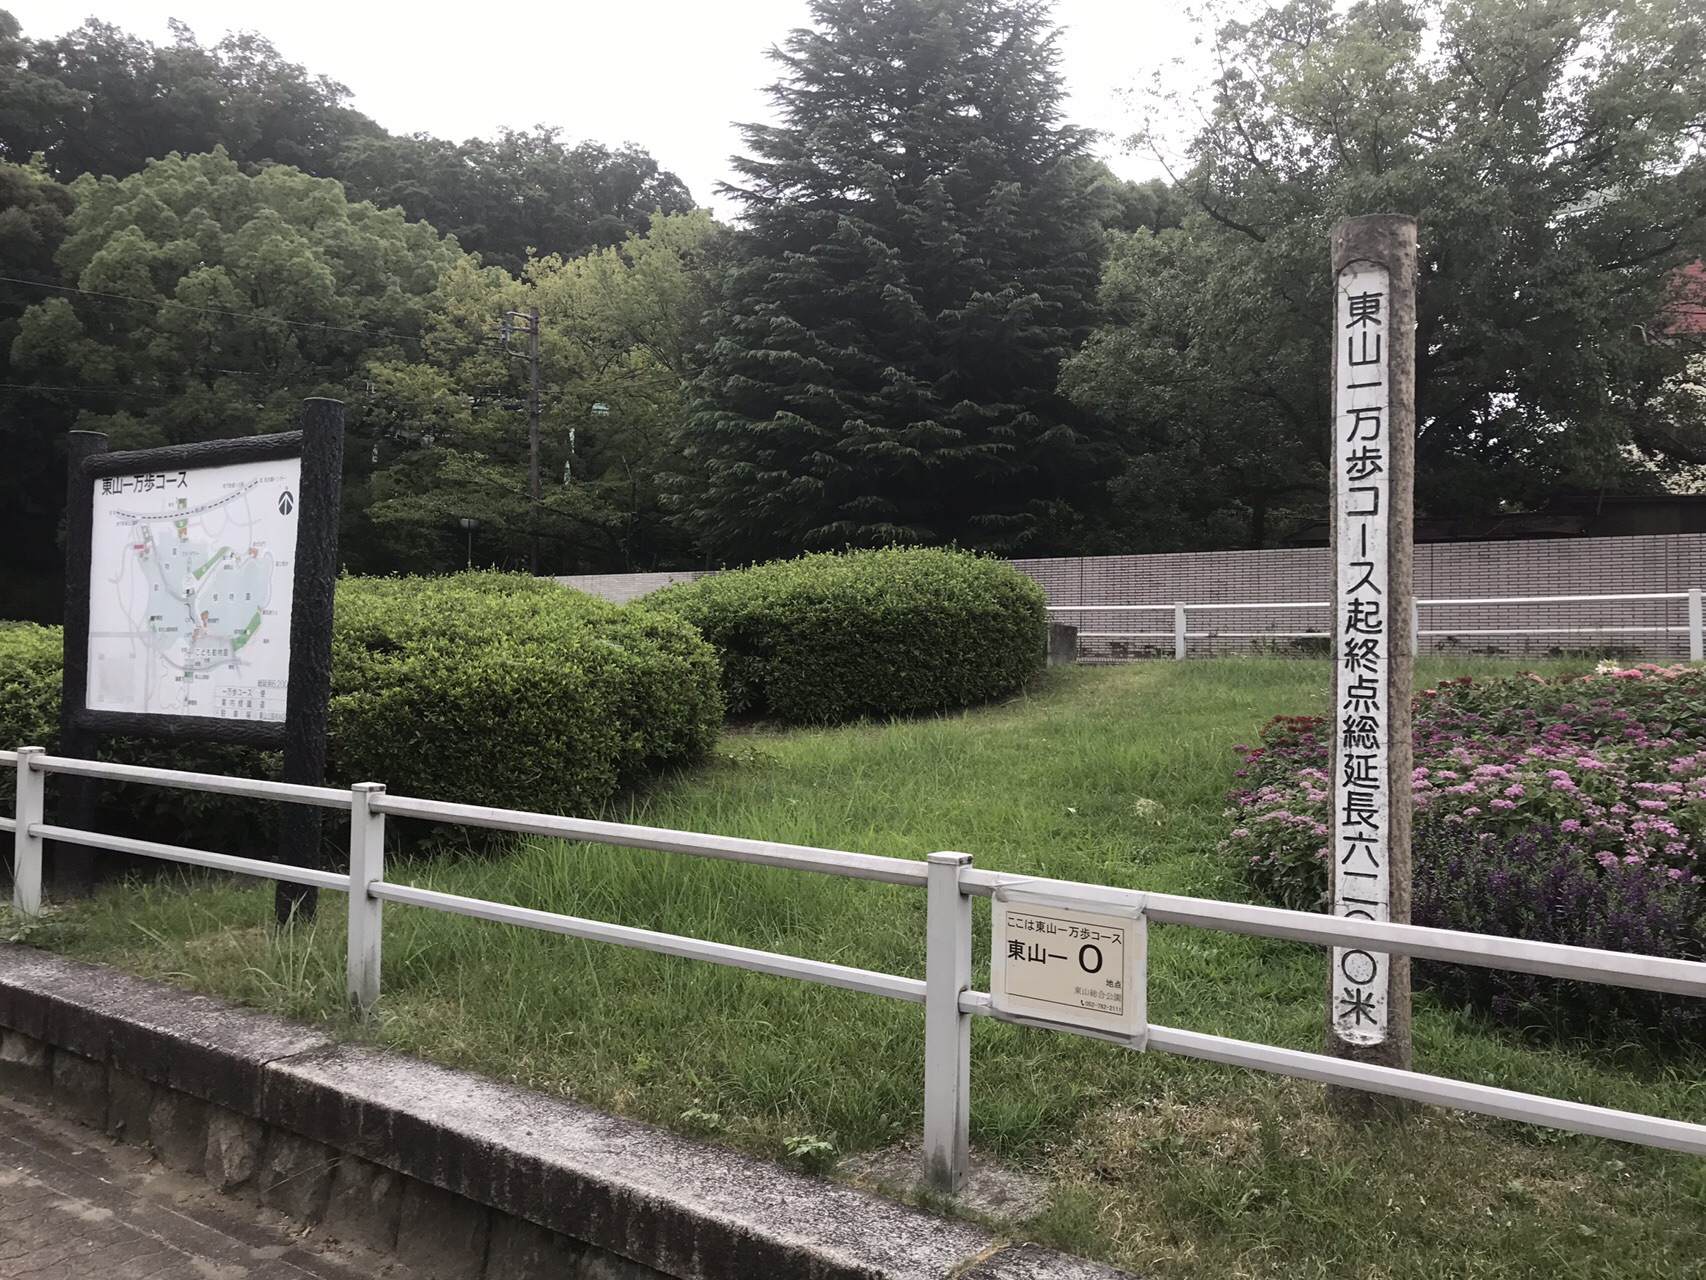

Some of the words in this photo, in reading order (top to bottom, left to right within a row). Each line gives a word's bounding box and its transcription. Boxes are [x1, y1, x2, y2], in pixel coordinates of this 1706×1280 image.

[102, 471, 187, 496] 東山一万歩コース
[1007, 917, 1122, 945] ここは東山一万歩コース
[1105, 978, 1122, 989] 地点
[1074, 986, 1122, 1002] 東山総合公園
